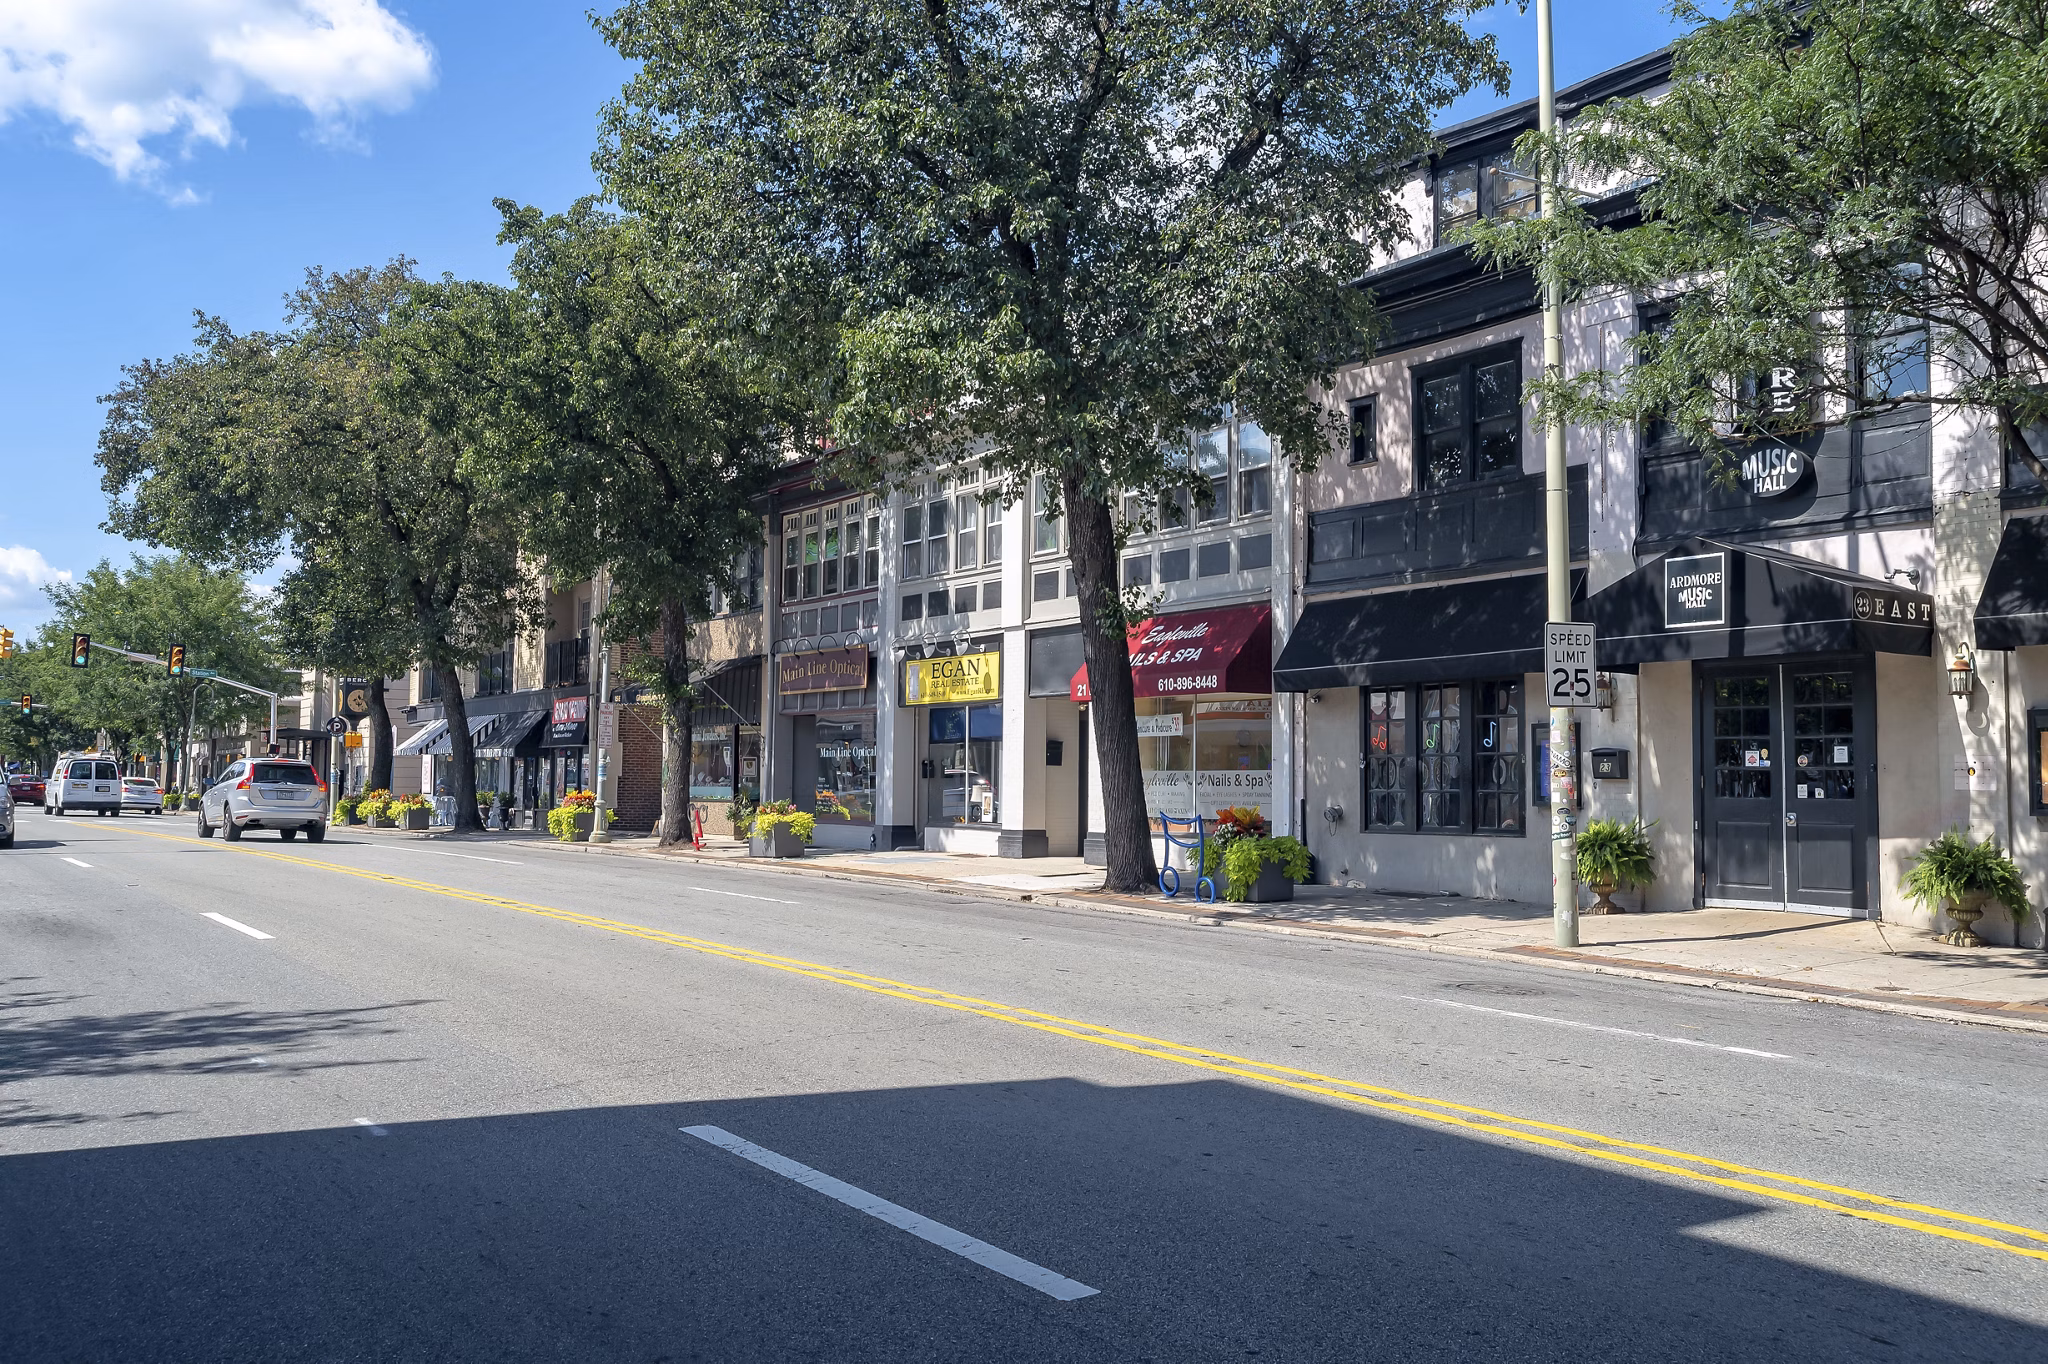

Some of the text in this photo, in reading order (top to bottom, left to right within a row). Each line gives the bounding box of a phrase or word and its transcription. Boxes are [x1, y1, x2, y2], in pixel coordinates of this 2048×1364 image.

[1742, 448, 1798, 480] MUSIC
[1753, 474, 1787, 494] HALL
[1669, 572, 1721, 589] ARDMORE
[1678, 586, 1712, 603] MUSIC
[1685, 600, 1706, 609] HALL
[1856, 596, 1931, 621] 23 EAST
[1141, 621, 1209, 648] Eagleville
[1550, 632, 1591, 646] SPEED
[1156, 650, 1171, 665] &
[1170, 647, 1203, 663] SPA
[1554, 650, 1586, 664] LIMIT
[782, 659, 865, 684] Main Line Optical
[931, 658, 981, 680] EGAN
[931, 676, 980, 689] REAL ESTATE
[1077, 683, 1087, 697] 21
[1158, 675, 1218, 692] 610-896-8448
[1552, 667, 1591, 698] 25
[820, 745, 877, 759] Main Line Optical
[1600, 763, 1611, 772] 23
[1207, 774, 1231, 787] Nails
[1234, 774, 1242, 787] &
[1245, 774, 1264, 790] Spa
